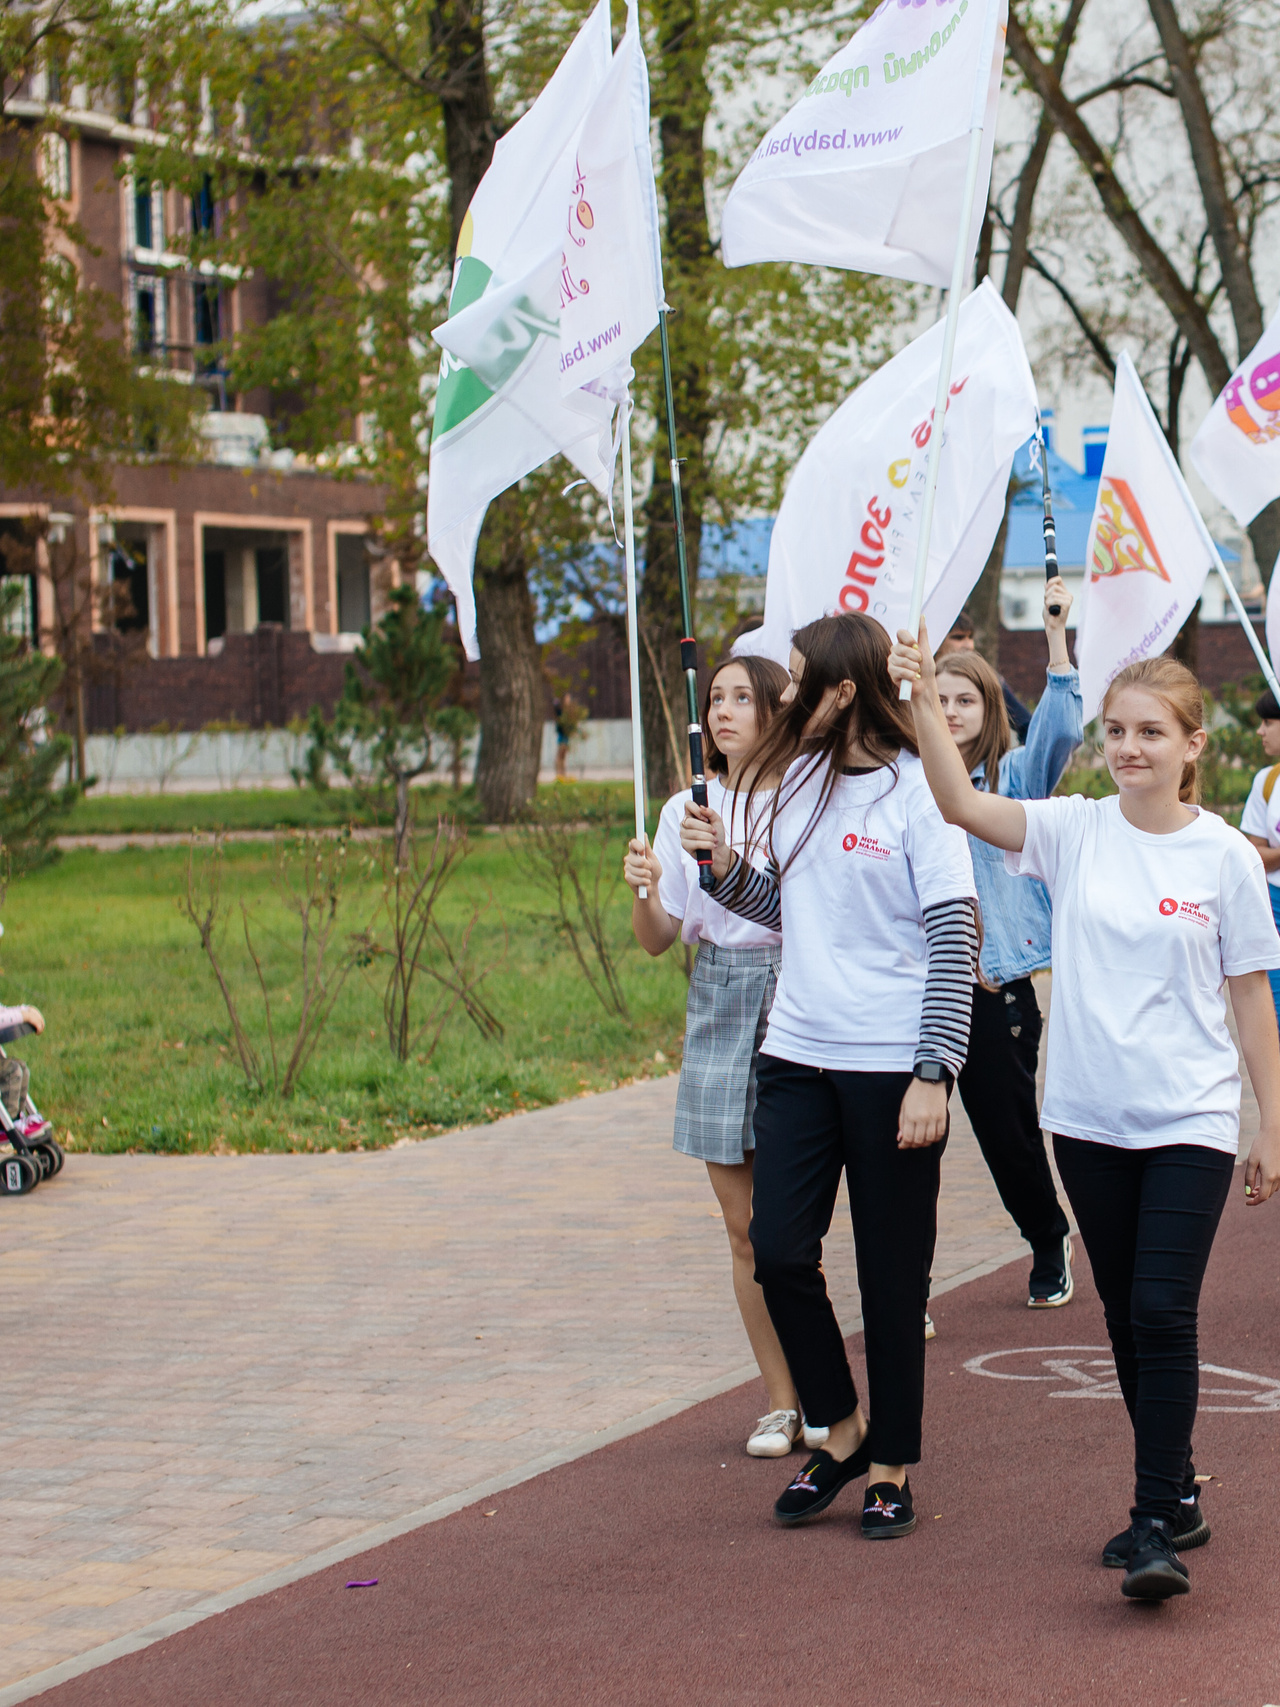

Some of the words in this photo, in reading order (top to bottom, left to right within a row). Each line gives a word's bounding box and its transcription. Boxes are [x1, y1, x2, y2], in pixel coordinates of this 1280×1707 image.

[860, 836, 879, 846] МОЙ
[858, 841, 891, 856] МАЛЫШ
[1181, 901, 1201, 911] МОЙ
[1179, 906, 1210, 922] МАЛЫШ
